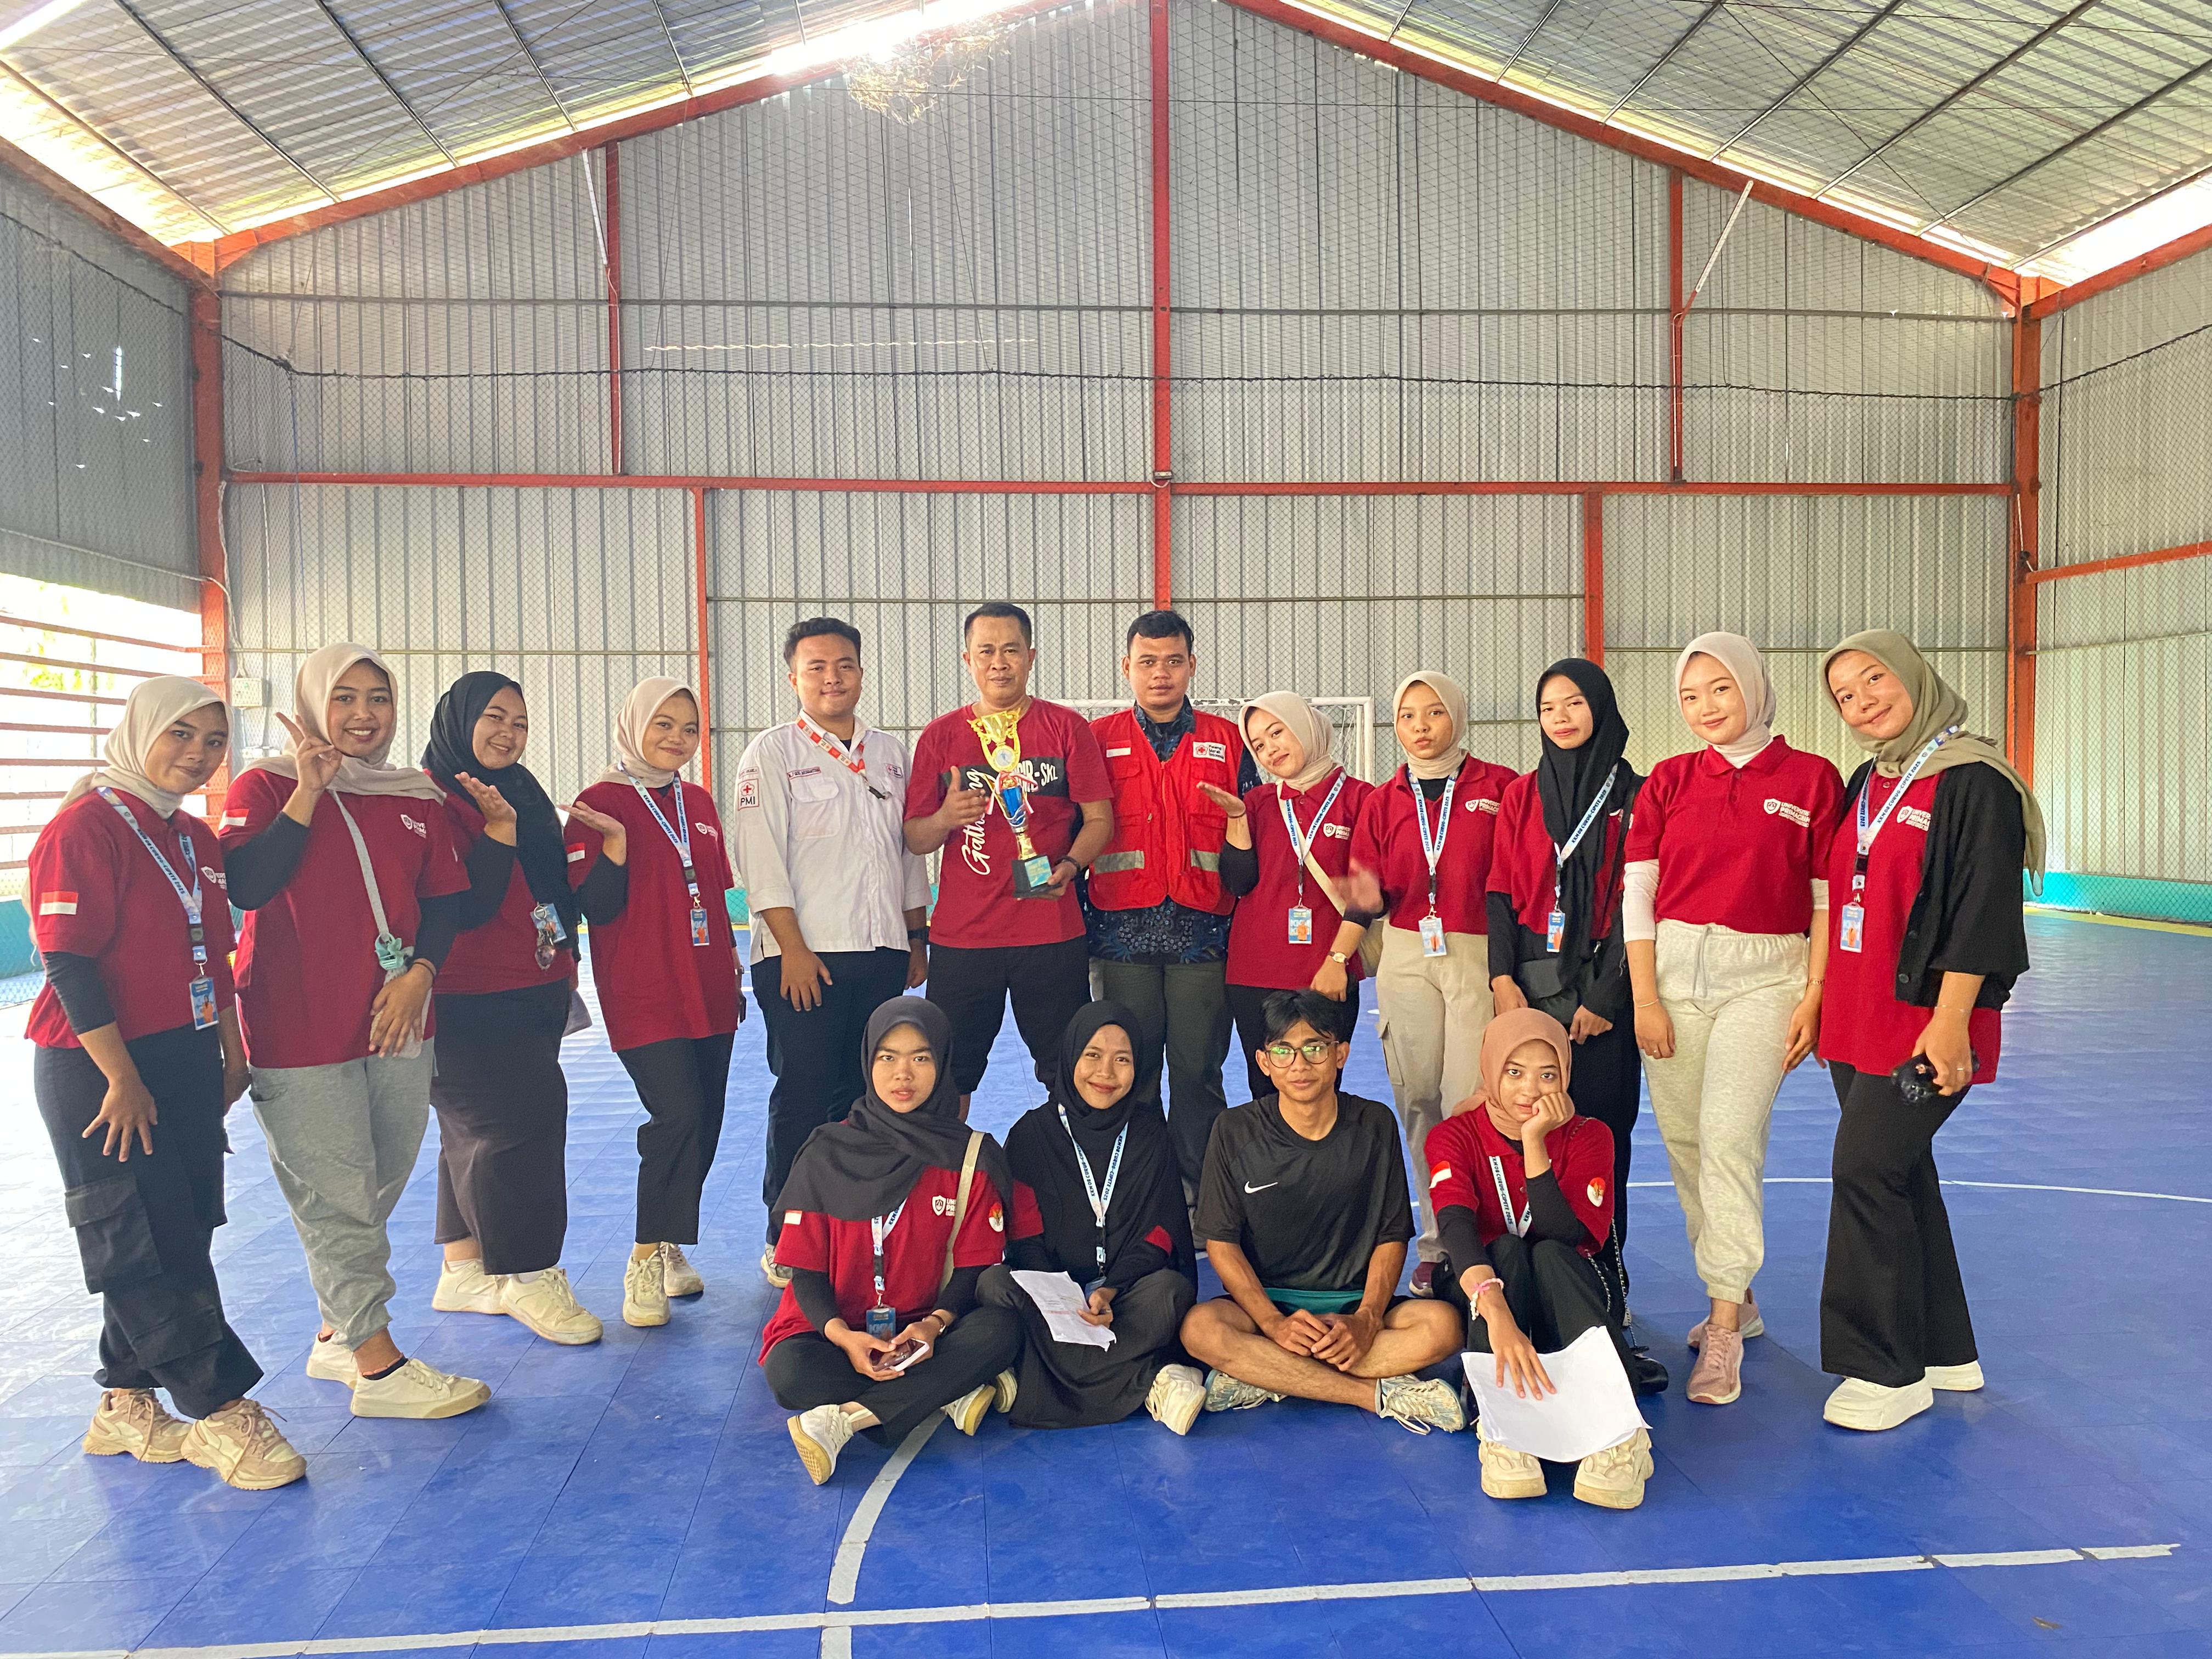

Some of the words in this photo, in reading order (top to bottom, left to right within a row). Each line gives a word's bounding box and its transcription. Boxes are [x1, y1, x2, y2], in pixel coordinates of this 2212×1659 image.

[1910, 760, 1921, 773] 2025
[740, 797, 755, 806] PMI
[961, 769, 996, 875] Gathng
[1107, 1152, 1118, 1187] CURUG-CIPETE
